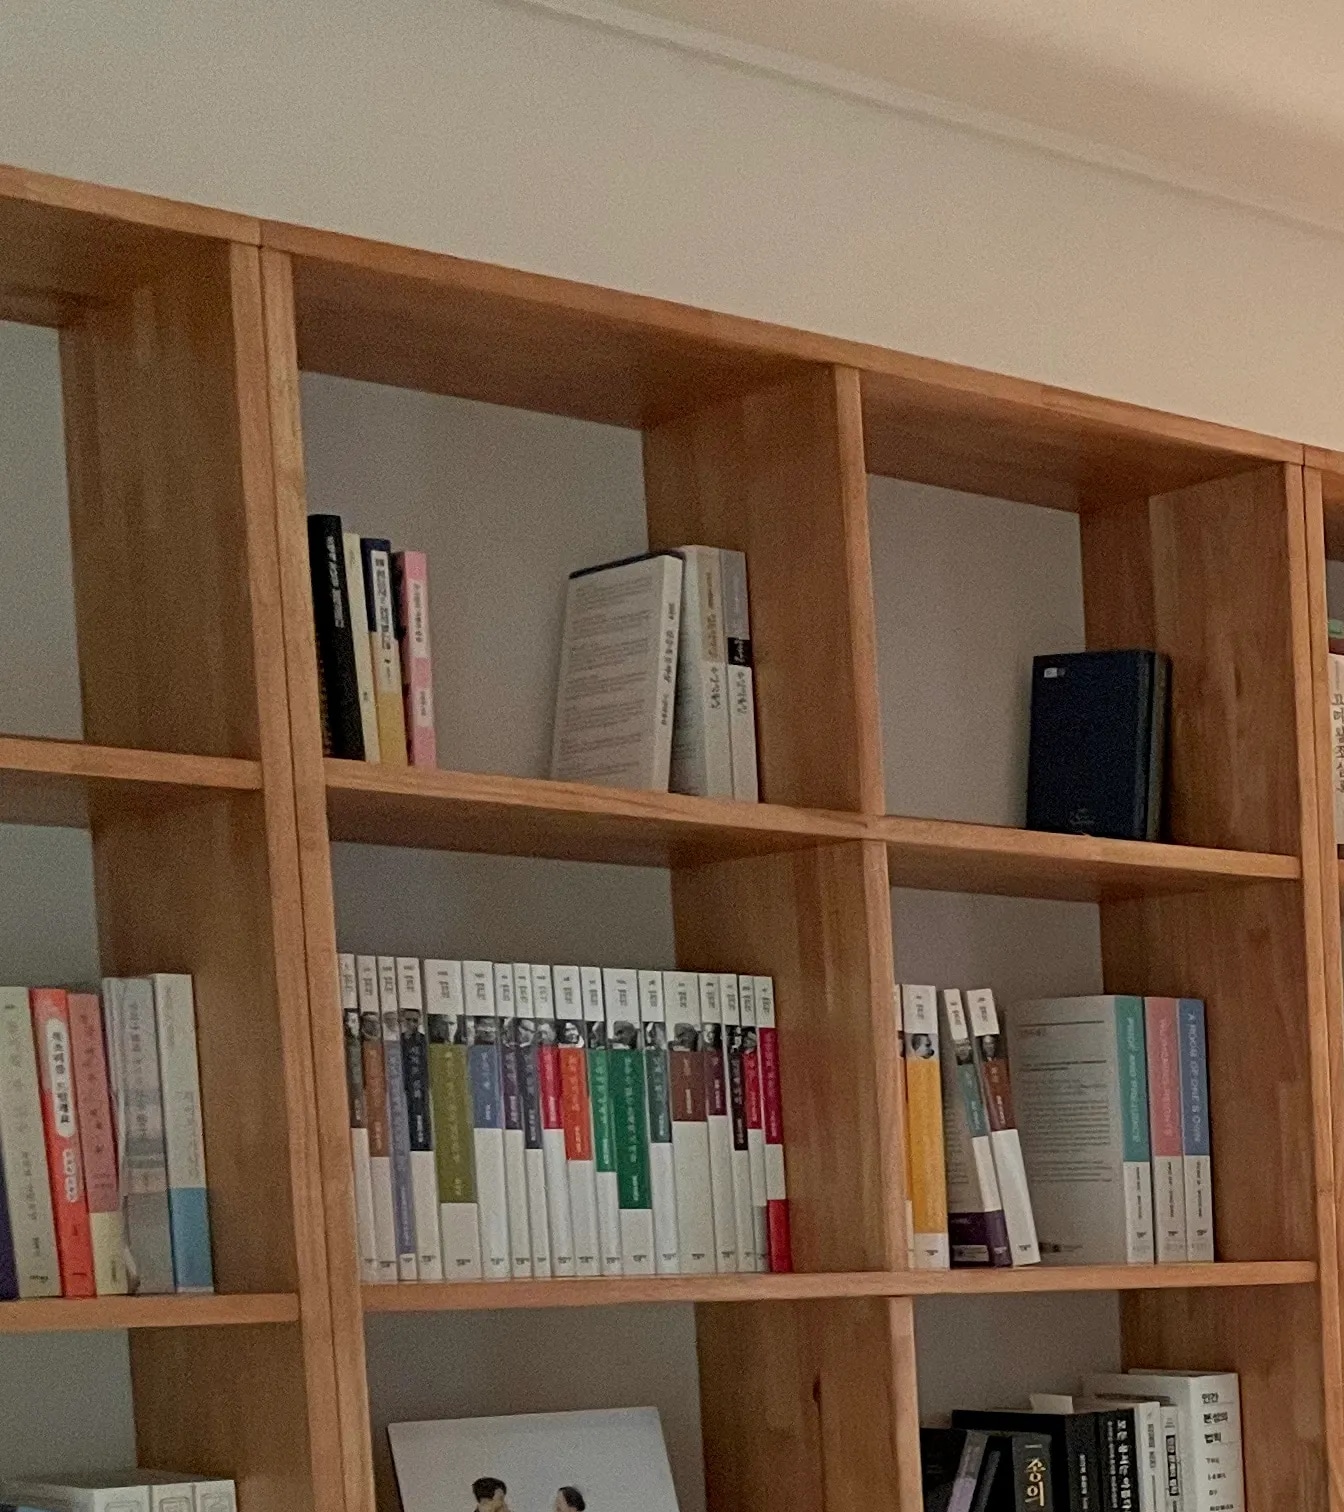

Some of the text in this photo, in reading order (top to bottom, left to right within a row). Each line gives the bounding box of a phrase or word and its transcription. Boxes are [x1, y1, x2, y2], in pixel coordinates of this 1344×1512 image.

[1201, 1392, 1228, 1444] 인간 본성의 법칙
[1024, 1457, 1047, 1508] 종의
[1117, 1443, 1131, 1476] 용서는
